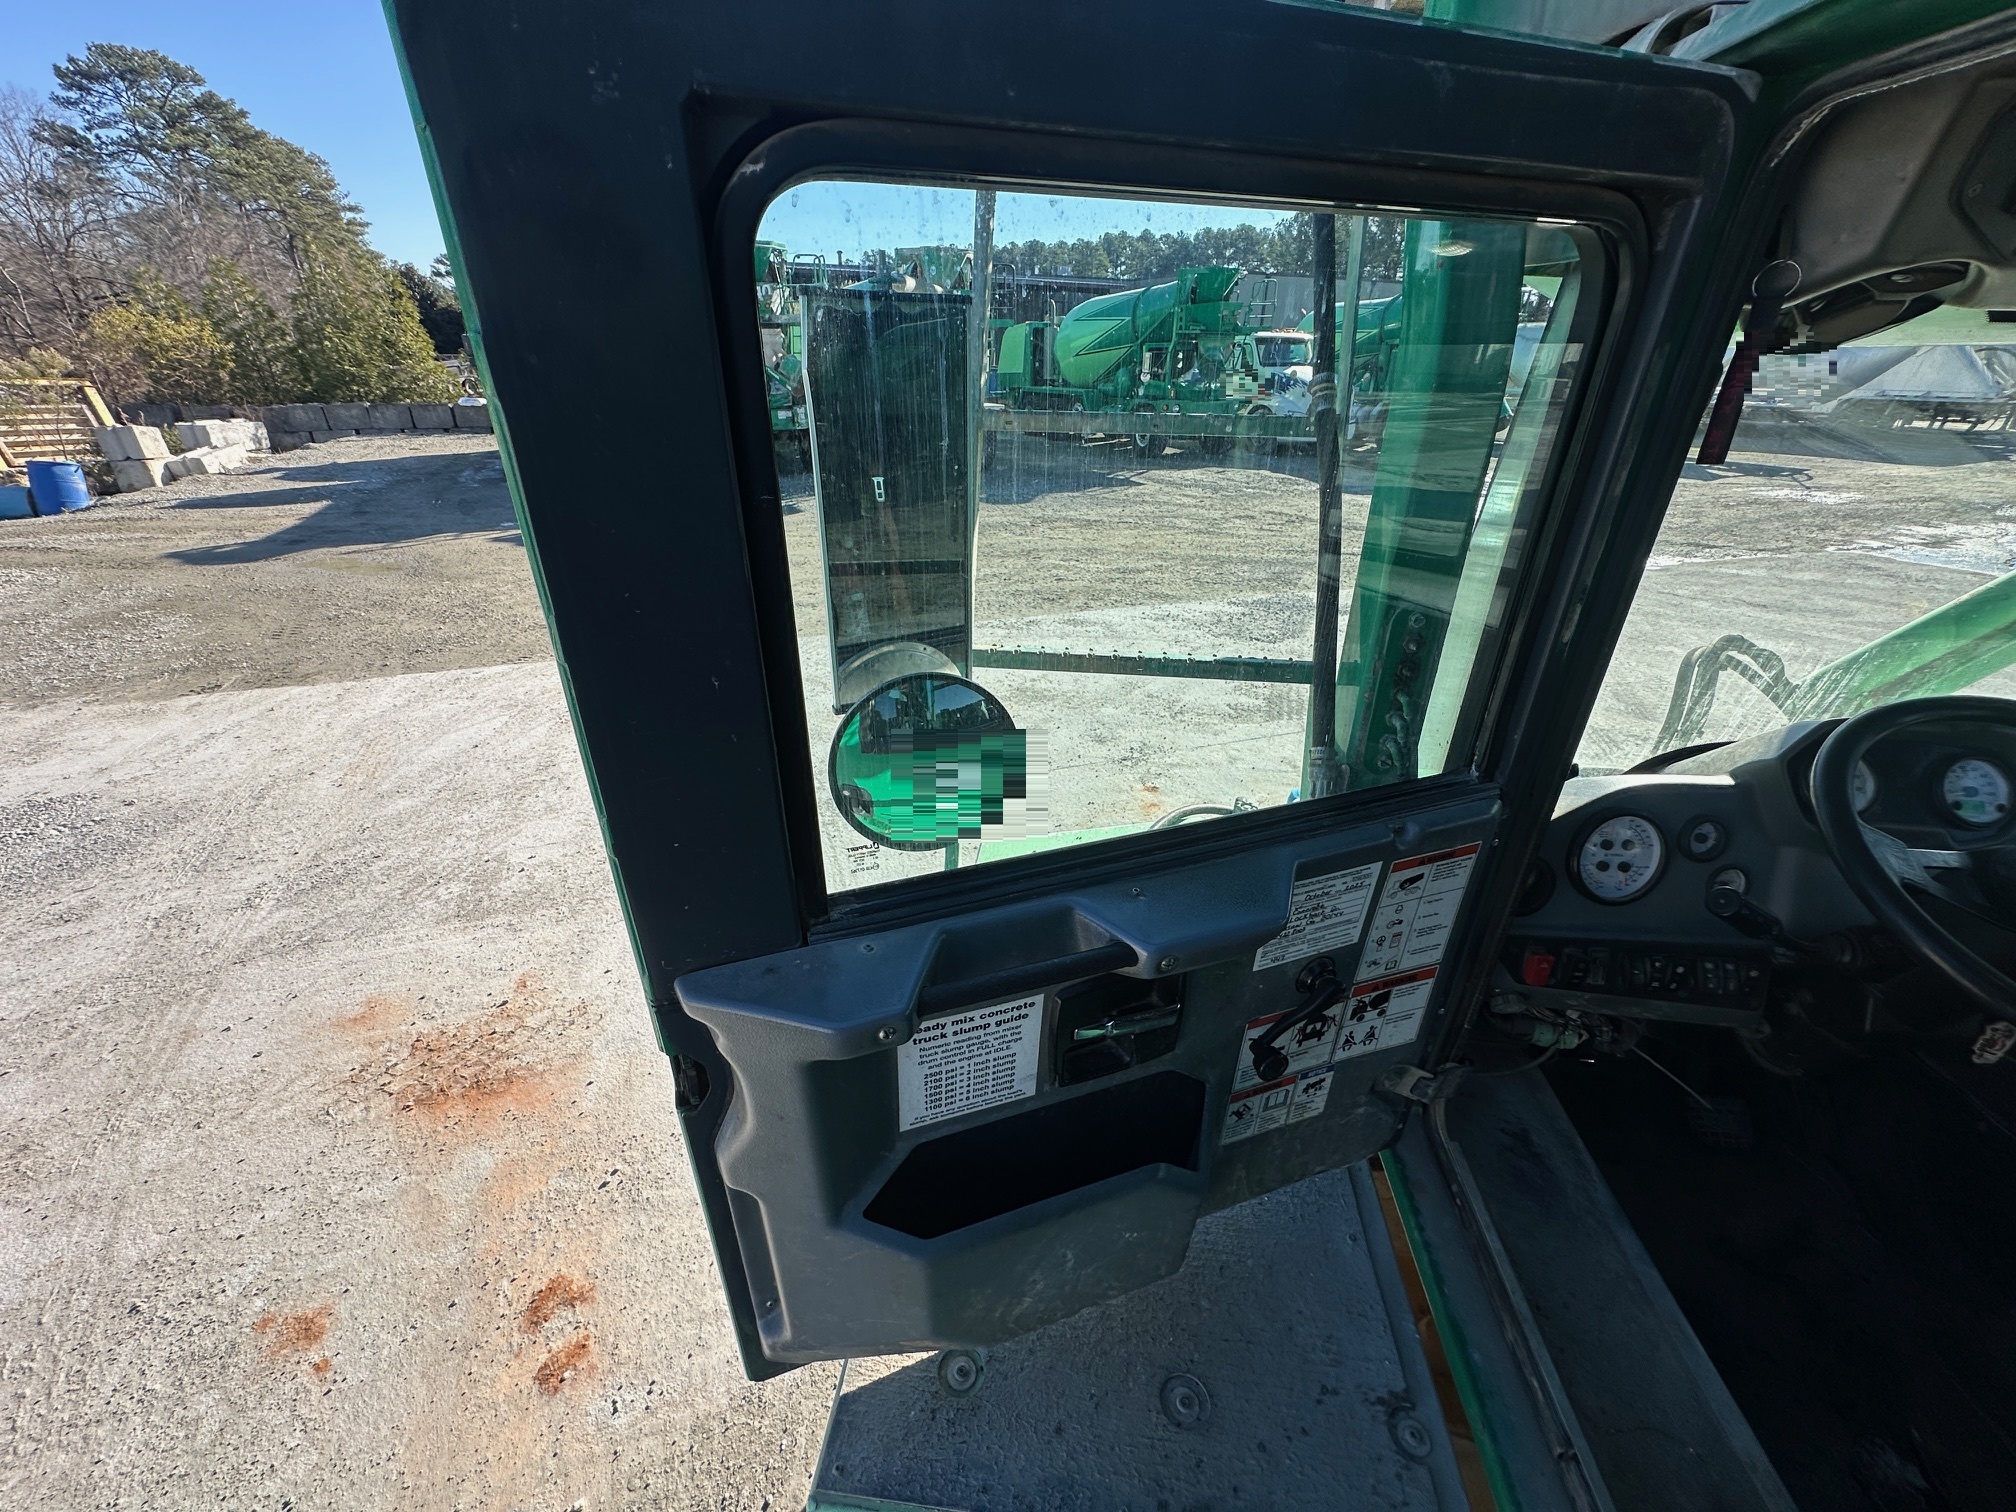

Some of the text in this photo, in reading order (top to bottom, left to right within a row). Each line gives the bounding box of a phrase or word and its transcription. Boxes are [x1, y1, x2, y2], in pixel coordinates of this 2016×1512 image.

[951, 1015, 976, 1026] mix
[980, 1001, 1036, 1019] concrete
[913, 1013, 1029, 1045] truck slump guide
[919, 1041, 951, 1053] Numeric
[953, 1034, 981, 1044] reading
[1002, 1024, 1022, 1033] mixer
[918, 1058, 938, 1066] drum
[940, 1050, 966, 1062] control
[977, 1042, 995, 1051] FULL
[998, 1036, 1022, 1046] charge
[920, 1051, 938, 1059] truck
[941, 1045, 963, 1055] slump
[928, 1062, 942, 1070] and
[958, 1053, 983, 1063] engine
[994, 1045, 1013, 1053] IDLE.
[924, 1070, 942, 1079] 2500
[945, 1067, 957, 1075] psi
[974, 1059, 990, 1067] inch
[993, 1052, 1016, 1062] slump
[924, 1077, 942, 1086] 2100
[945, 1073, 957, 1082] psi
[974, 1065, 990, 1073] inch
[992, 1059, 1016, 1069] slump
[924, 1084, 942, 1092] 1700
[945, 1080, 957, 1088] psi
[973, 1072, 989, 1080] inch
[992, 1066, 1016, 1075] slump
[924, 1097, 942, 1106] 1300
[945, 1094, 956, 1102] psi
[973, 1084, 989, 1092] inch
[991, 1079, 1015, 1088] slump
[945, 1087, 957, 1095] psi
[973, 1078, 989, 1086] inch
[992, 1072, 1015, 1081] slump
[924, 1104, 942, 1112] 1100
[944, 1100, 956, 1108] psi
[972, 1091, 988, 1099] inch
[991, 1085, 1014, 1094] slump
